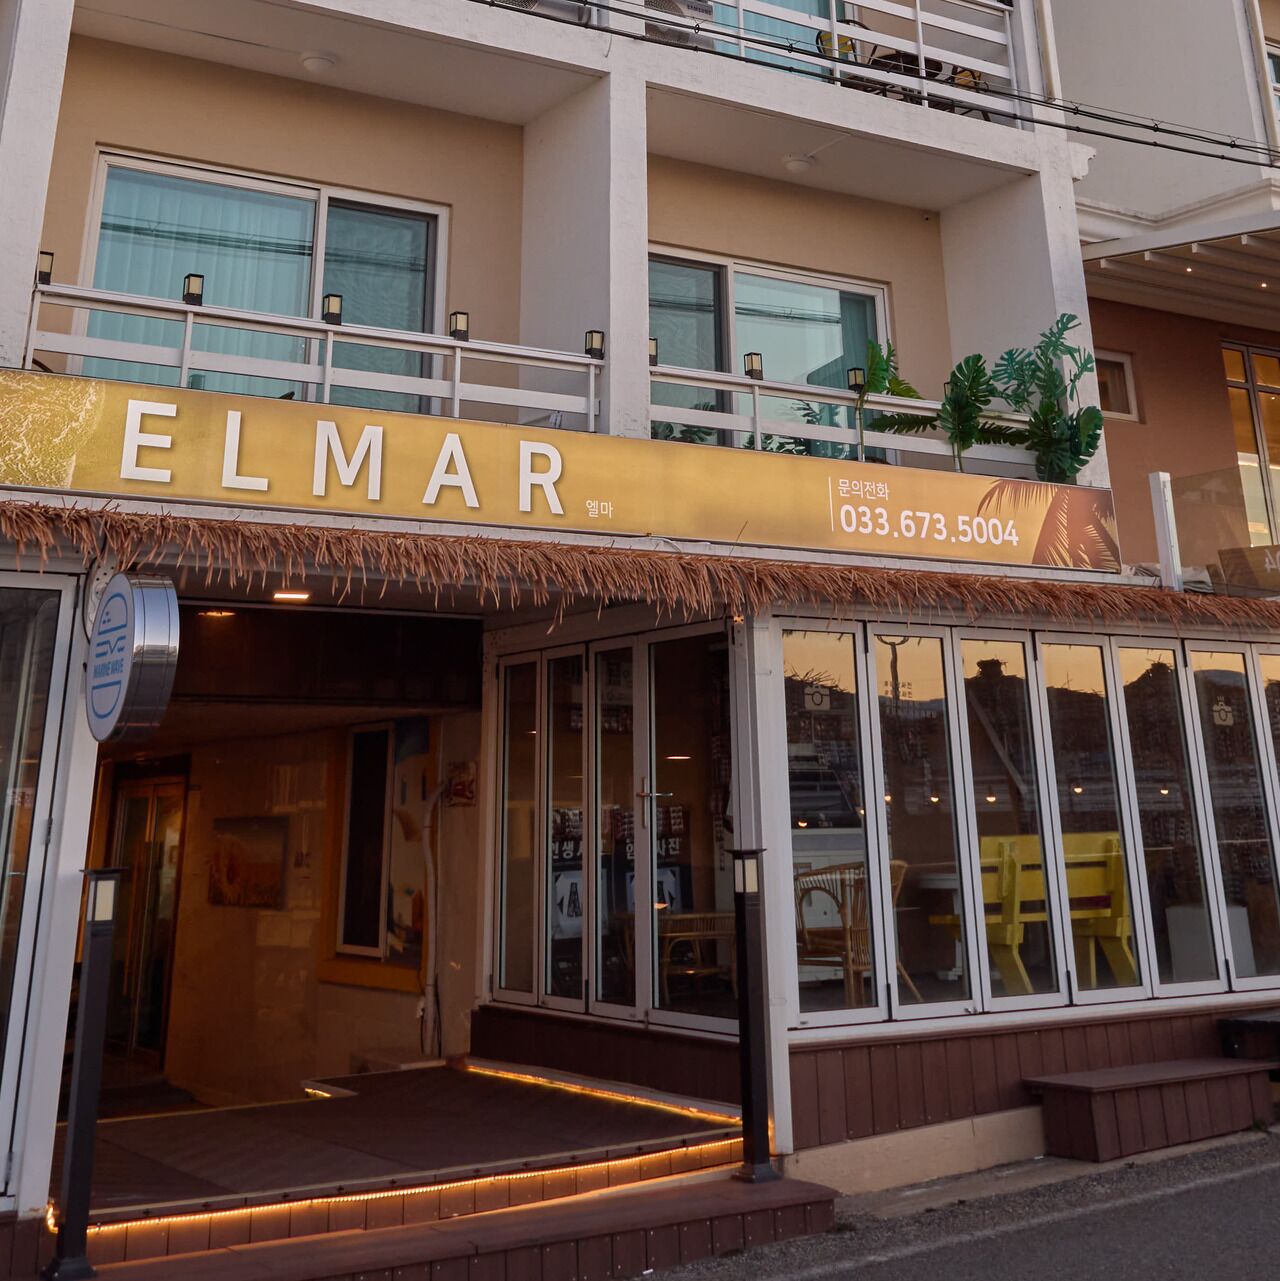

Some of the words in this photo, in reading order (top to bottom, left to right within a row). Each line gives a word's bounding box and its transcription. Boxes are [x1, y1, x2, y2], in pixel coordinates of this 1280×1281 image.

[120, 399, 567, 516] ELMAR
[837, 478, 891, 501] 문의전화
[585, 498, 614, 520] 엘마
[839, 504, 1020, 547] 033.673.5004
